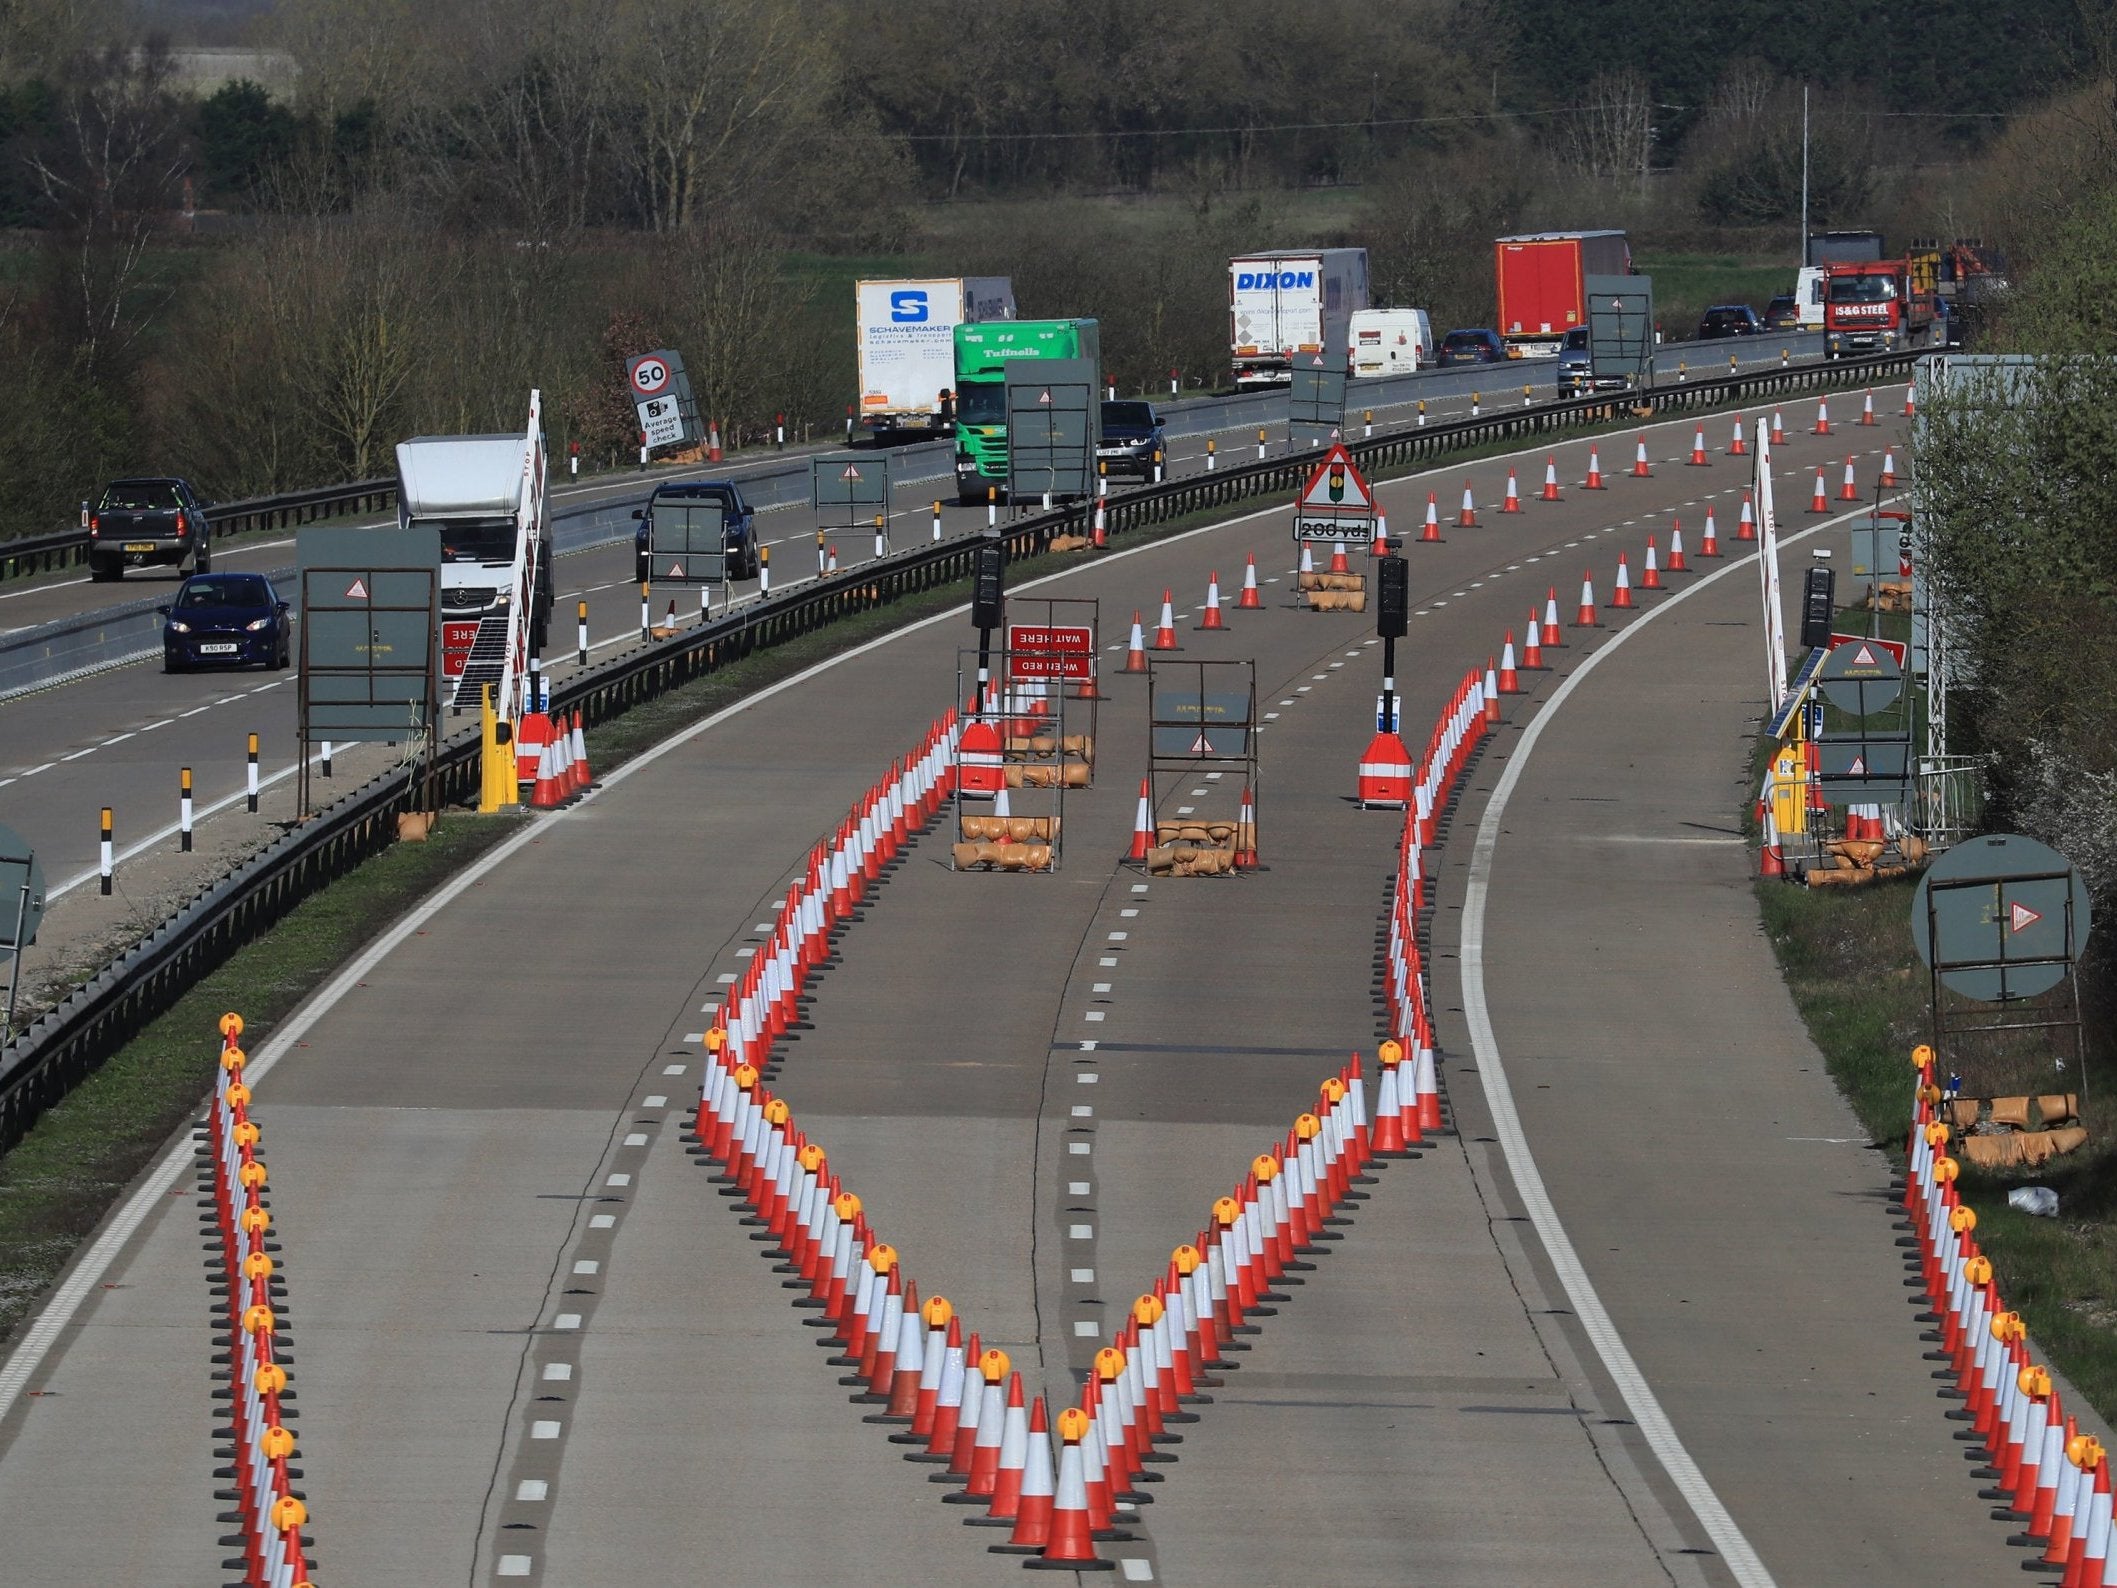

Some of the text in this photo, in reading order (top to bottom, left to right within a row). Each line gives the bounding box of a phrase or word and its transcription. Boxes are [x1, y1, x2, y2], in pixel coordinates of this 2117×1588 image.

[1237, 272, 1313, 290] DIXON
[1861, 302, 1889, 315] STEEL
[869, 325, 951, 334] SCHAVEMAKER
[983, 347, 1040, 358] Tuffnells
[638, 366, 664, 385] 50
[644, 416, 677, 429] Average
[651, 424, 675, 436] speed
[653, 432, 677, 443] check
[523, 451, 532, 477] STOP
[1767, 510, 1776, 535] STOP
[1302, 523, 1337, 536] 200
[1056, 634, 1081, 643] WAIT
[1022, 661, 1043, 670] RED
